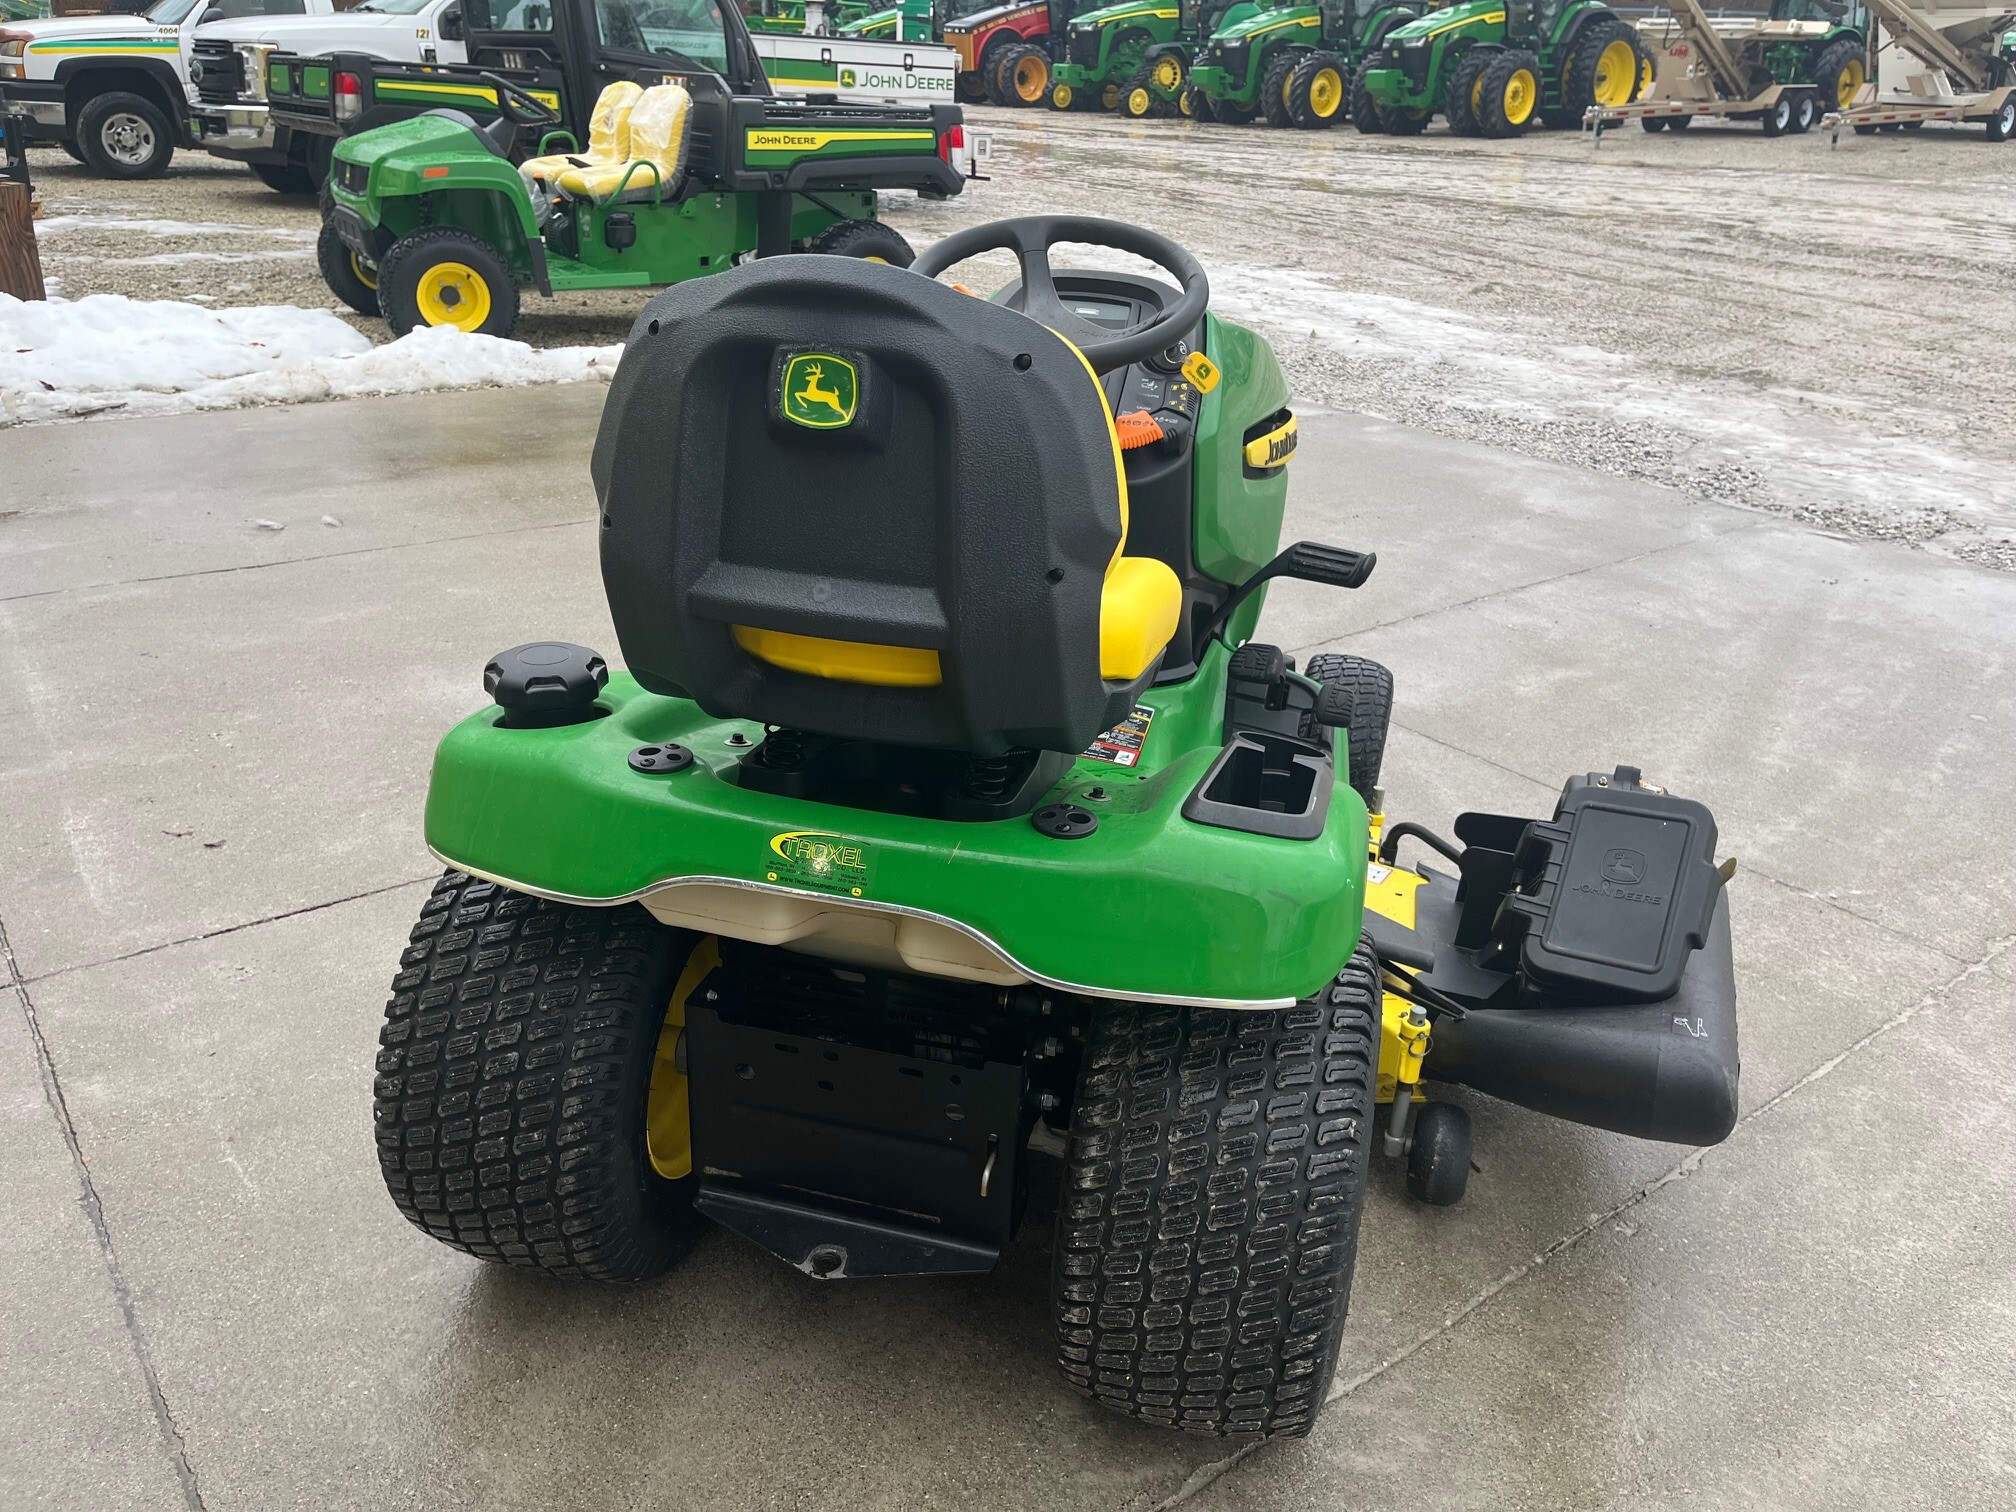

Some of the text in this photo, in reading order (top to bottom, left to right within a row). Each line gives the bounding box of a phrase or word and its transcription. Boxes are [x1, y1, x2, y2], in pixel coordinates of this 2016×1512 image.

[416, 29, 430, 39] 121
[860, 71, 954, 91] JOHN DEERE
[754, 135, 817, 145] JOHN DEERE
[785, 836, 867, 869] TROXEL
[1572, 882, 1662, 906] JOHN DEERE
